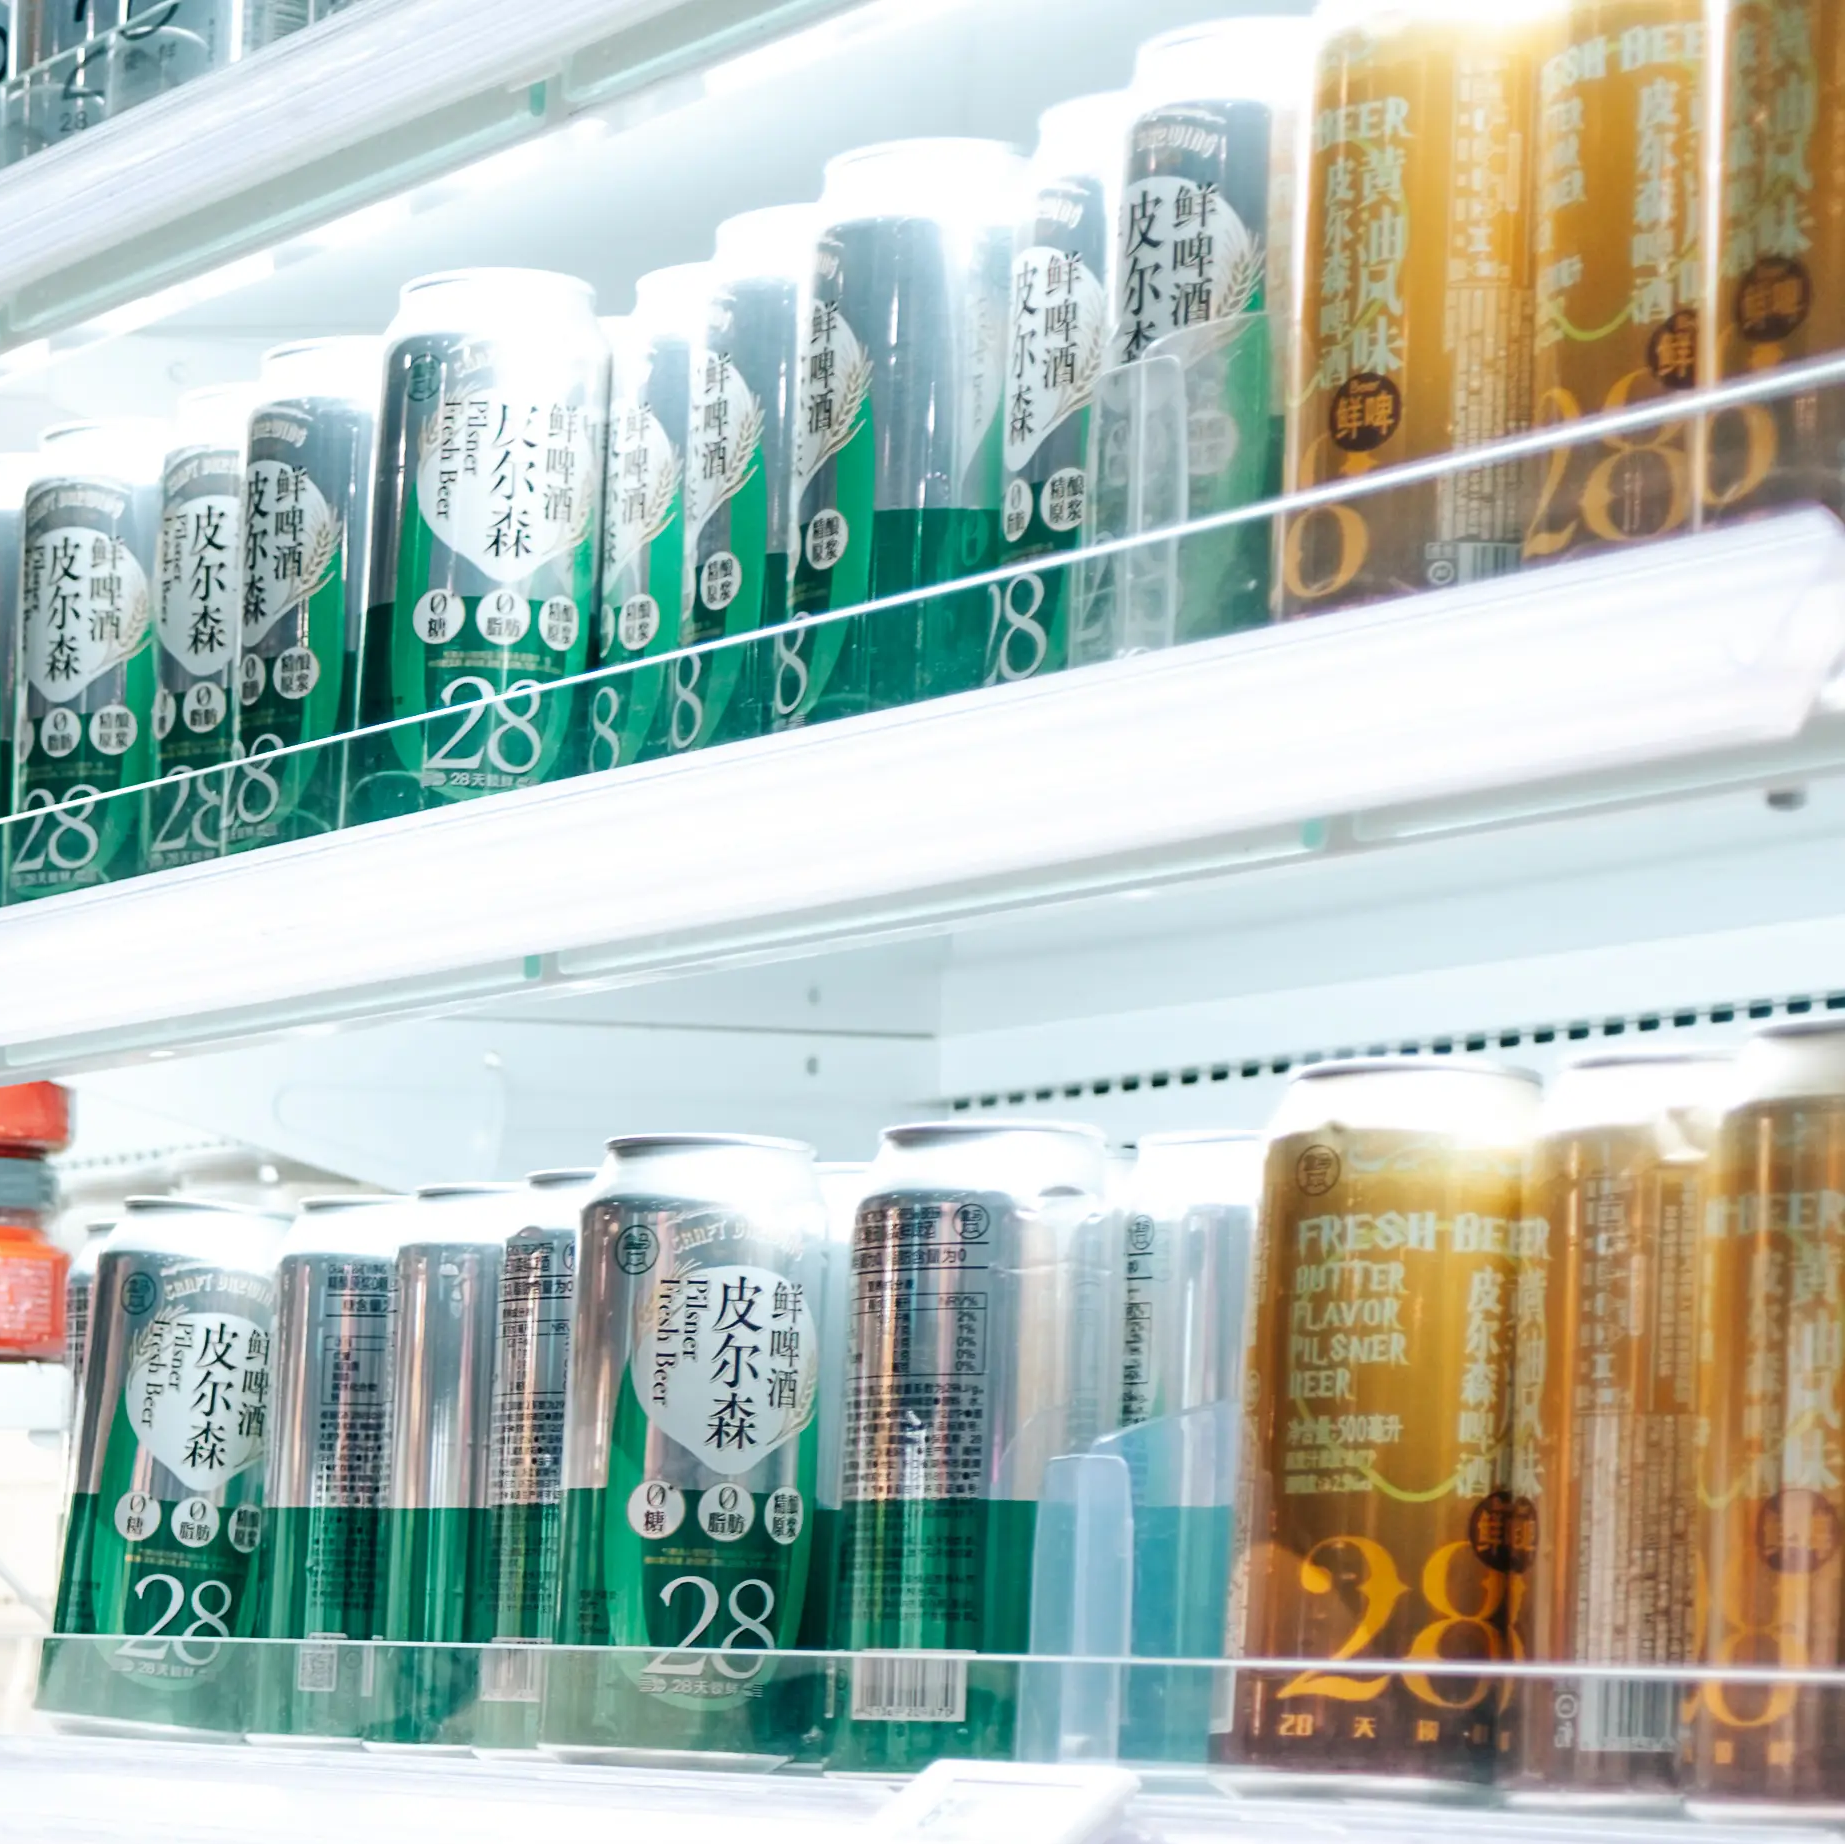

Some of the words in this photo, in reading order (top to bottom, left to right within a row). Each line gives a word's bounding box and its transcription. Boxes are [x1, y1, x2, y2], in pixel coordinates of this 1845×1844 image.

[1171, 183, 1220, 327] 鲜啤酒
[1353, 149, 1406, 371] 黄油风味
[809, 302, 839, 435] 鲜啤酒
[1043, 250, 1084, 390] 鲜啤酒
[463, 401, 488, 476] Pilsner
[544, 403, 577, 523] 鲜啤酒
[622, 403, 651, 524] 鲜啤酒
[701, 354, 732, 480] 鲜啤酒
[1336, 394, 1395, 436] 鲜啤
[274, 467, 309, 580] 鲜啤酒
[435, 469, 460, 521] Beer
[89, 536, 125, 641] 鲜啤酒
[188, 506, 227, 656] 皮尔森
[242, 471, 269, 628] 皮尔森
[46, 537, 81, 683] 皮尔森
[425, 675, 542, 774] 28
[11, 784, 101, 873] 28
[1296, 1259, 1409, 1295] BUTTER
[1298, 1211, 1437, 1260] FRESH
[1453, 1214, 1551, 1261] BEER
[168, 1320, 195, 1393] Pilsner
[658, 1279, 681, 1349] Fresh
[683, 1279, 709, 1361] Pilsner
[706, 1276, 763, 1450] 皮尔森
[767, 1281, 804, 1410] 鲜啤酒
[1290, 1334, 1410, 1367] PILSNER
[1292, 1299, 1403, 1332] FLAVOR
[184, 1322, 239, 1471] 皮尔森
[238, 1327, 271, 1440] 鲜啤酒
[652, 1352, 677, 1408] Beer
[1290, 1368, 1355, 1402] BEER
[1457, 1266, 1506, 1497] 皮尔森啤酒
[707, 1511, 747, 1535] 脂肪
[114, 1572, 232, 1667] 28
[642, 1576, 776, 1679] 28
[1276, 1536, 1526, 1709] 28
